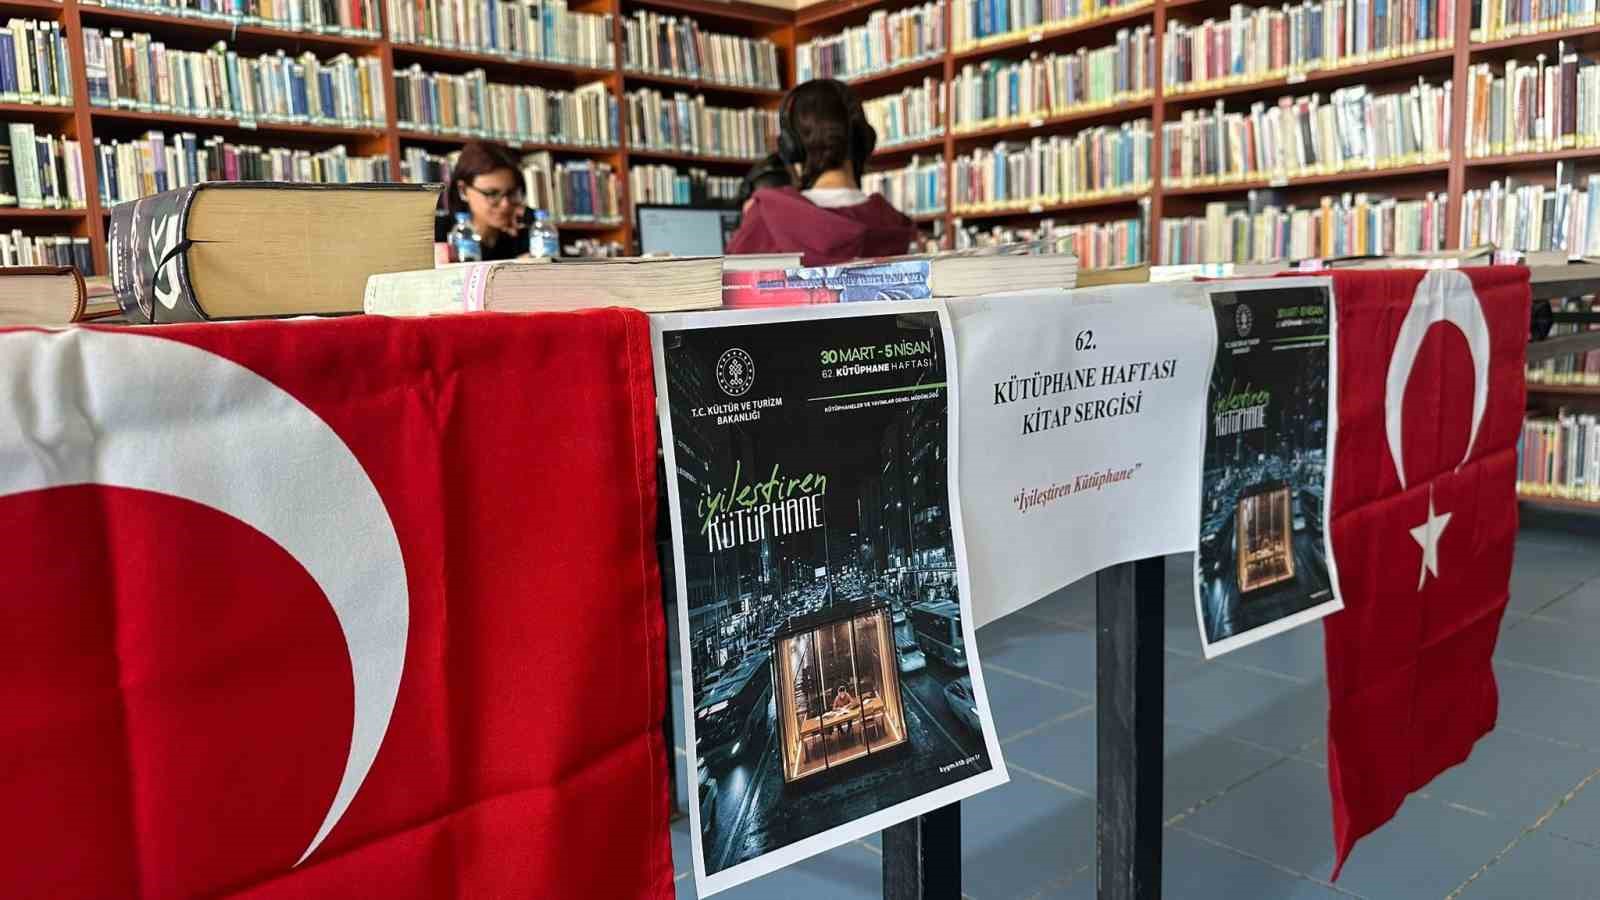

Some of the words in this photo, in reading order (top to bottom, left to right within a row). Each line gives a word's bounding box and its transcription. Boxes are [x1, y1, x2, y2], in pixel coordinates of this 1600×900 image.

[820, 349, 838, 365] 30
[839, 345, 876, 363] MART
[885, 344, 893, 358] 5
[894, 338, 931, 357] NİSAN
[1075, 330, 1096, 351] 62.
[836, 362, 890, 377] KÜTÜPHANE
[891, 357, 932, 371] HAFTASI
[993, 366, 1097, 405] KÜTÜPHANE
[1100, 359, 1177, 386] HAFTASI
[691, 407, 707, 418] T.C.
[707, 401, 739, 416] KÜLTÜR
[740, 401, 751, 411] VE
[752, 396, 783, 409] TURİZM
[717, 409, 760, 425] BAKANLIĞI
[1022, 405, 1071, 436] KİTAP
[1074, 390, 1143, 424] SERGİSİ
[698, 459, 827, 536] iyileştiren
[708, 493, 824, 553] KÜTÜPHANE
